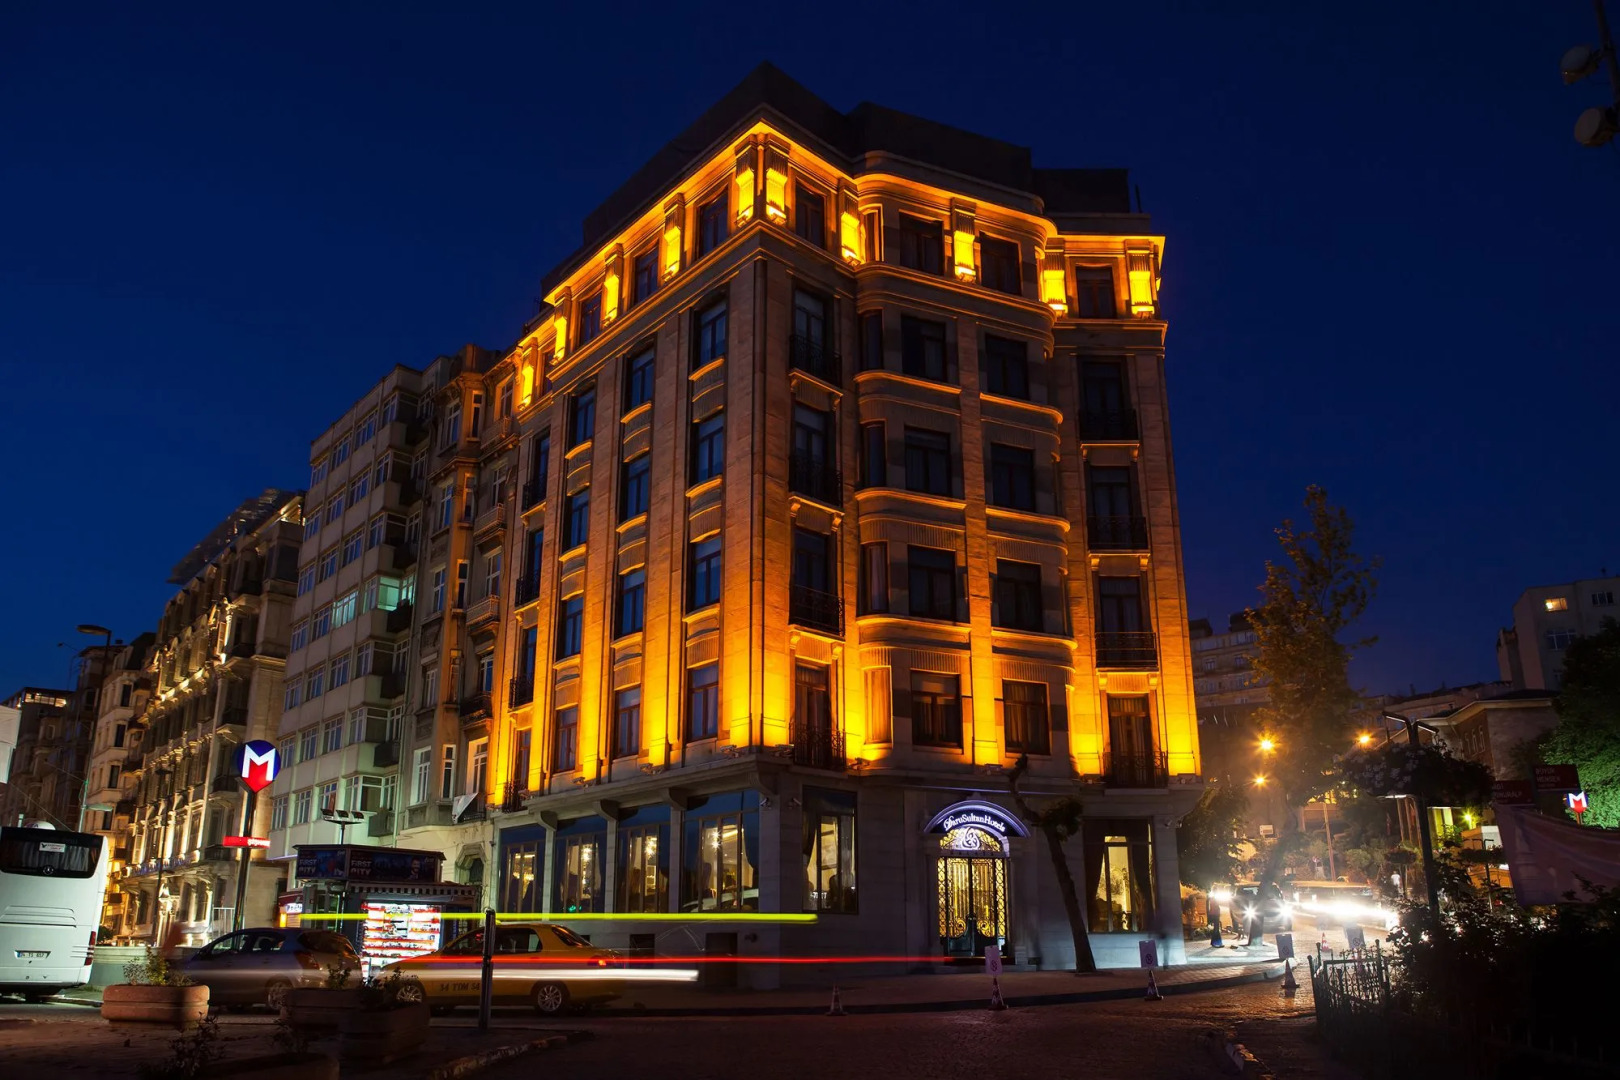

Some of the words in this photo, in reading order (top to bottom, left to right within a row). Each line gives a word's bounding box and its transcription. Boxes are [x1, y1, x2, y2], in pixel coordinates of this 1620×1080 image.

[242, 744, 276, 782] M
[1568, 791, 1587, 808] M
[351, 860, 372, 868] FIRST
